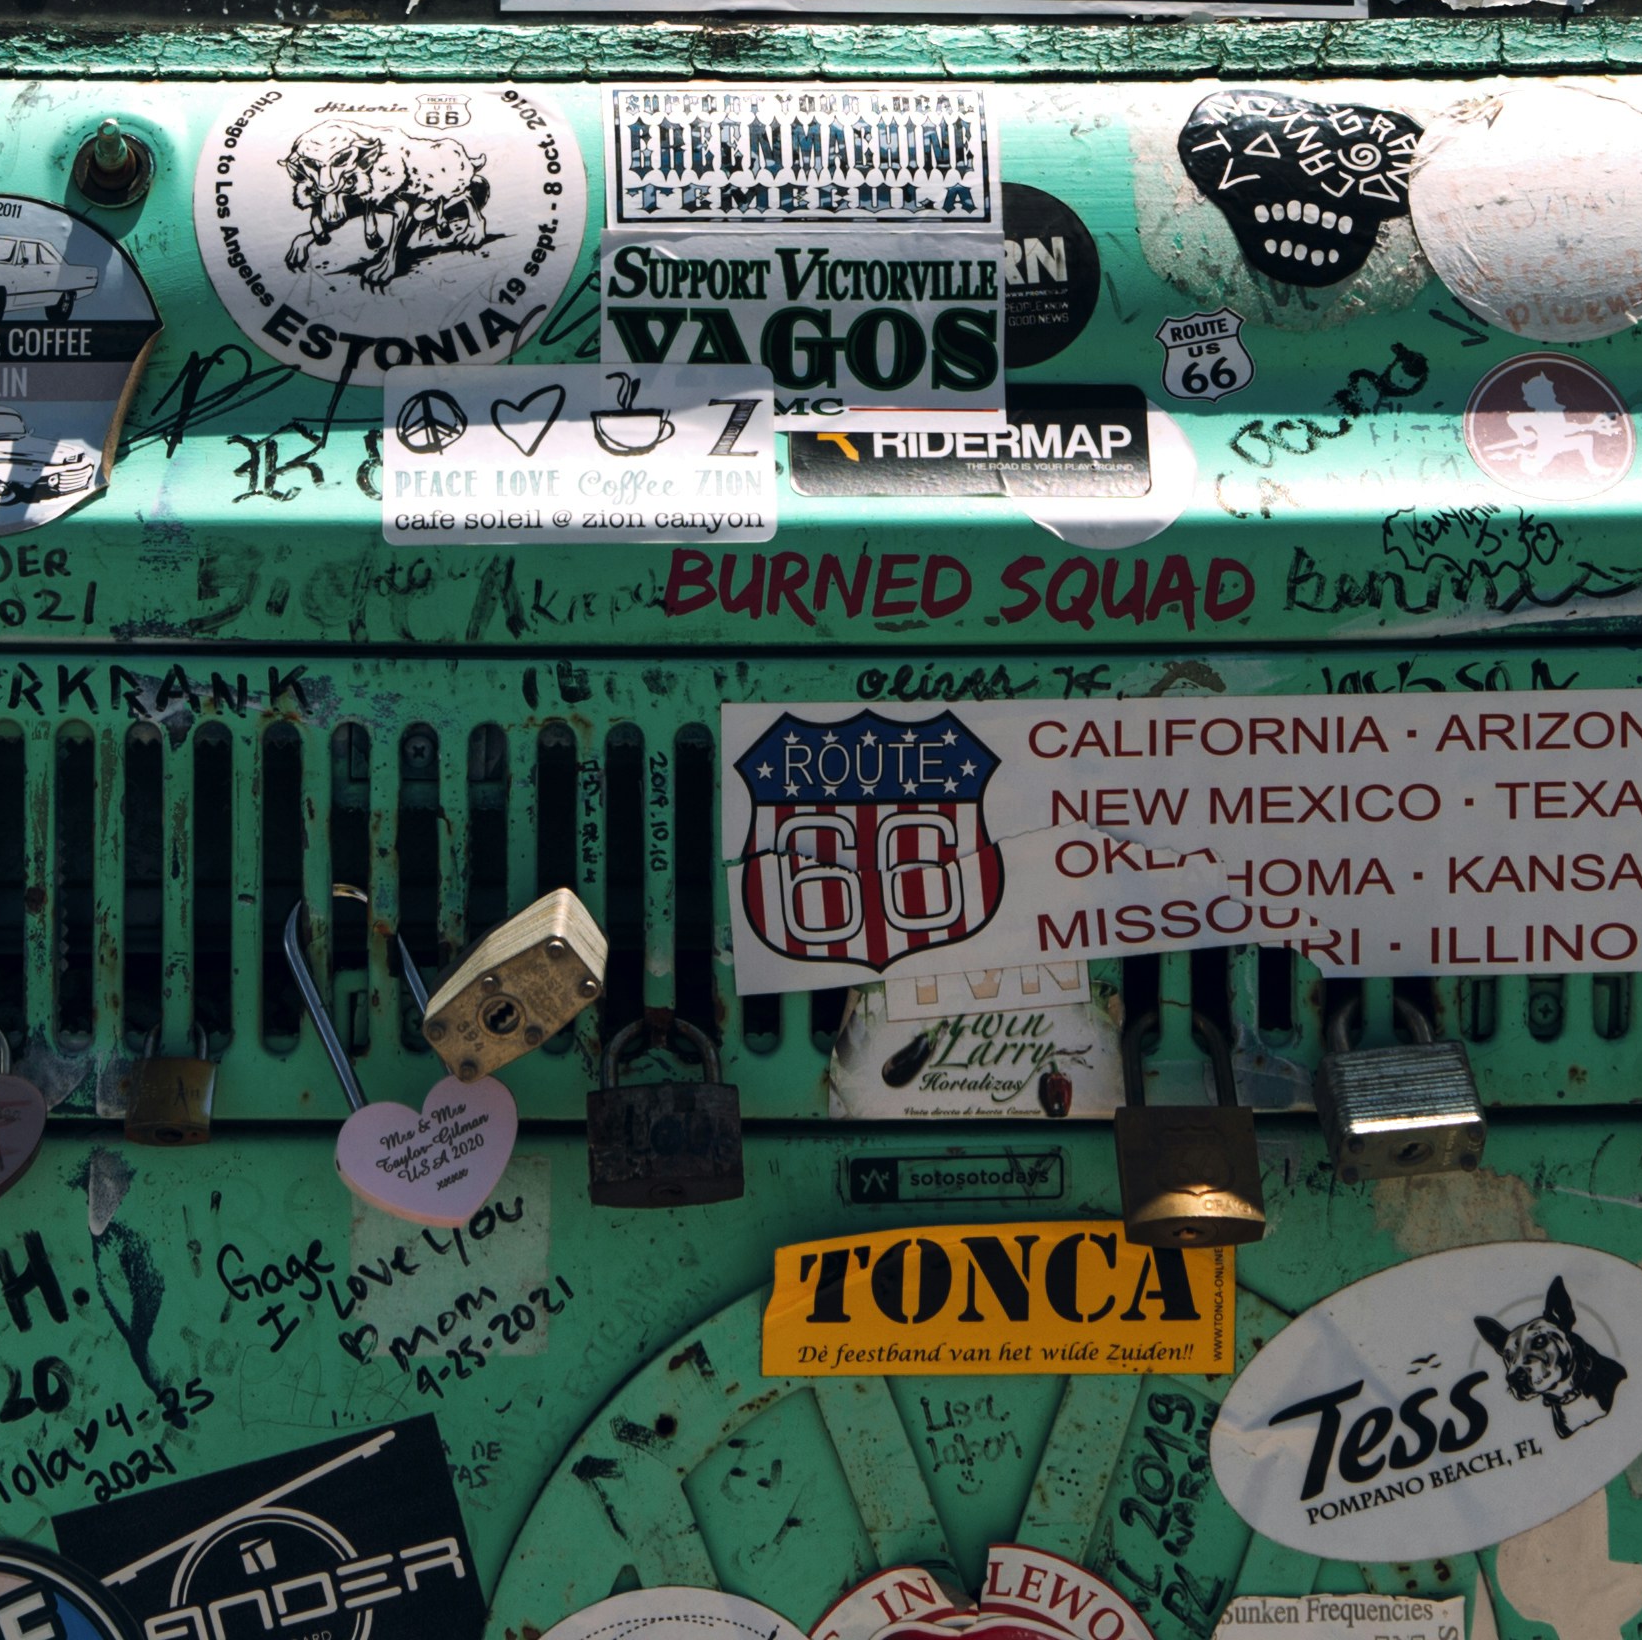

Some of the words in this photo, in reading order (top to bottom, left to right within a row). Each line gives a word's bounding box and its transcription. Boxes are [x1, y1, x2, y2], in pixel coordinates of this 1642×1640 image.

[9, 327, 92, 357] COFFEE
[262, 303, 523, 372] ESTONIA
[608, 307, 999, 391] VAGOS
[1170, 317, 1229, 344] ROUTE
[1187, 342, 1222, 359] US
[1180, 365, 1237, 395] 66
[873, 425, 1133, 459] RIDERMAP
[394, 509, 455, 531] cafe
[464, 507, 545, 531] soleil
[553, 508, 575, 529] @
[582, 508, 644, 529] zion
[653, 510, 764, 536] canyon
[664, 549, 973, 624] BURNED
[999, 555, 1256, 632] SQUAD
[1028, 715, 1388, 759] CALIFORNIA
[785, 743, 947, 787] ROUTE
[1051, 787, 1189, 828] NEW
[1210, 782, 1442, 824] MEXICO
[918, 1070, 1025, 1096] Hortalizas
[800, 1233, 1201, 1326] TONCA
[833, 1342, 944, 1370] feestband
[950, 1345, 991, 1365] van
[998, 1342, 1034, 1363] het
[1041, 1341, 1101, 1363] wilde
[1268, 1370, 1489, 1503] Tess
[1306, 1475, 1424, 1526] POMPANO
[1429, 1446, 1511, 1493] BEACH,
[1516, 1438, 1544, 1460] FL
